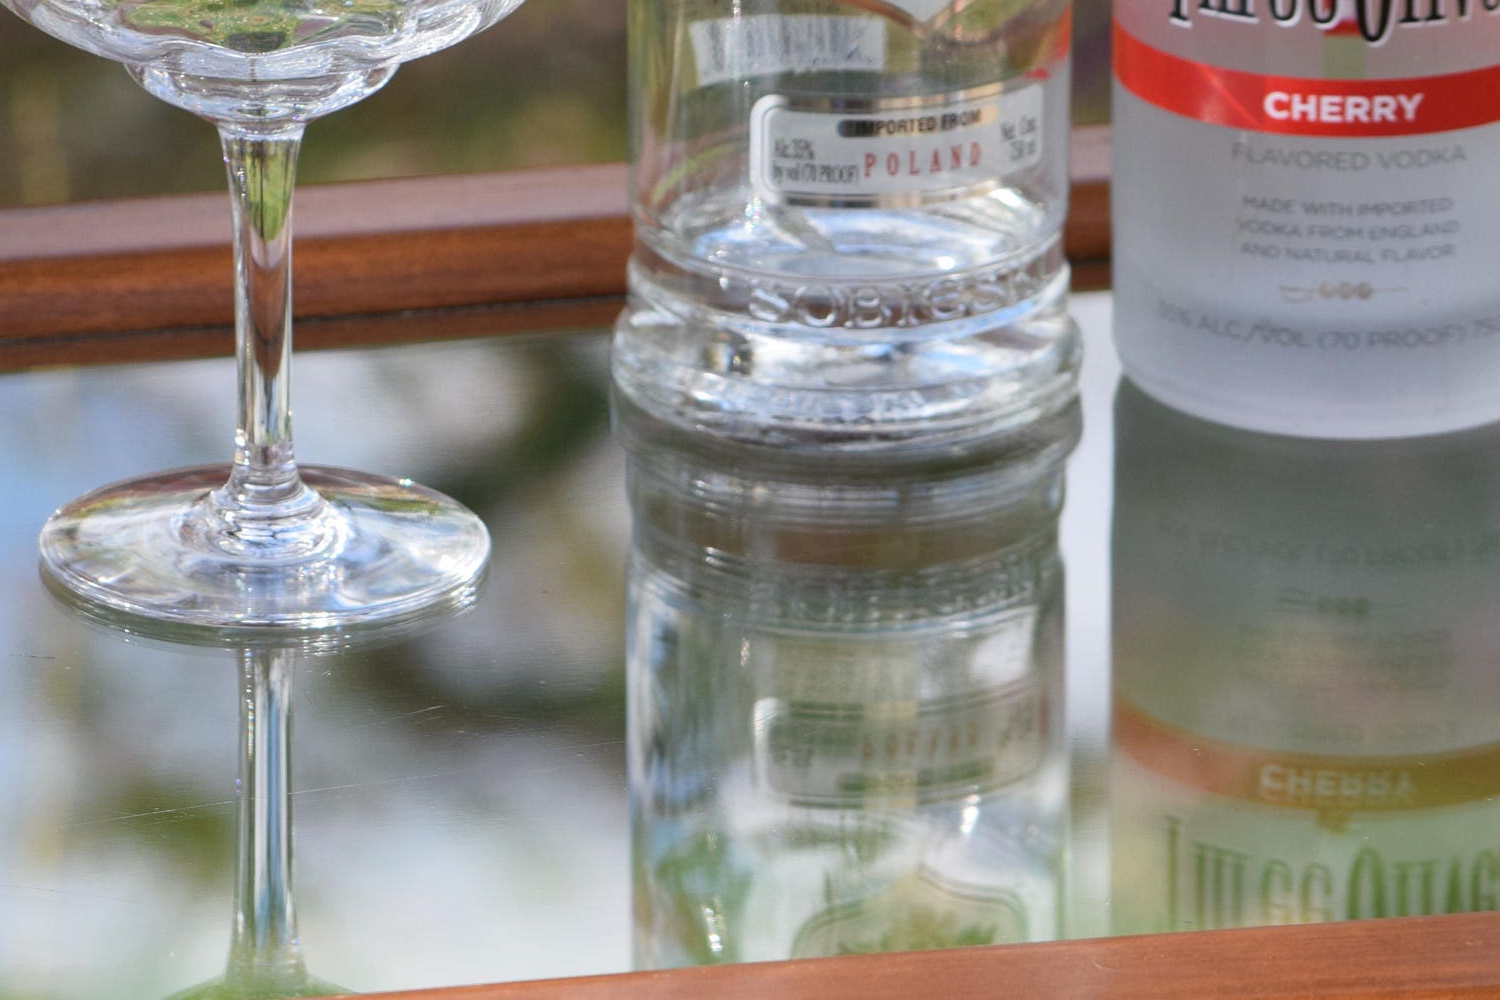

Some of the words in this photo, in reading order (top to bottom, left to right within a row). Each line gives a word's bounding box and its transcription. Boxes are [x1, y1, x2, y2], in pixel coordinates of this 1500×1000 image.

[1263, 91, 1424, 123] CHERRY
[855, 116, 937, 136] IMPORTED
[941, 108, 981, 131] FROM
[863, 141, 982, 178] POLAND
[1232, 141, 1372, 171] FLAVORED
[1376, 144, 1468, 169] VODKA
[1241, 195, 1296, 214] MADE
[1301, 201, 1353, 216] WITH
[1356, 196, 1454, 217] IMPORTED
[1236, 217, 1303, 238] VODKA
[1307, 224, 1366, 240] FROM
[1368, 219, 1461, 241] ENGLAND
[1240, 242, 1282, 260] AND
[1285, 247, 1377, 265] NATURAL
[1379, 243, 1456, 263] FLAVOR
